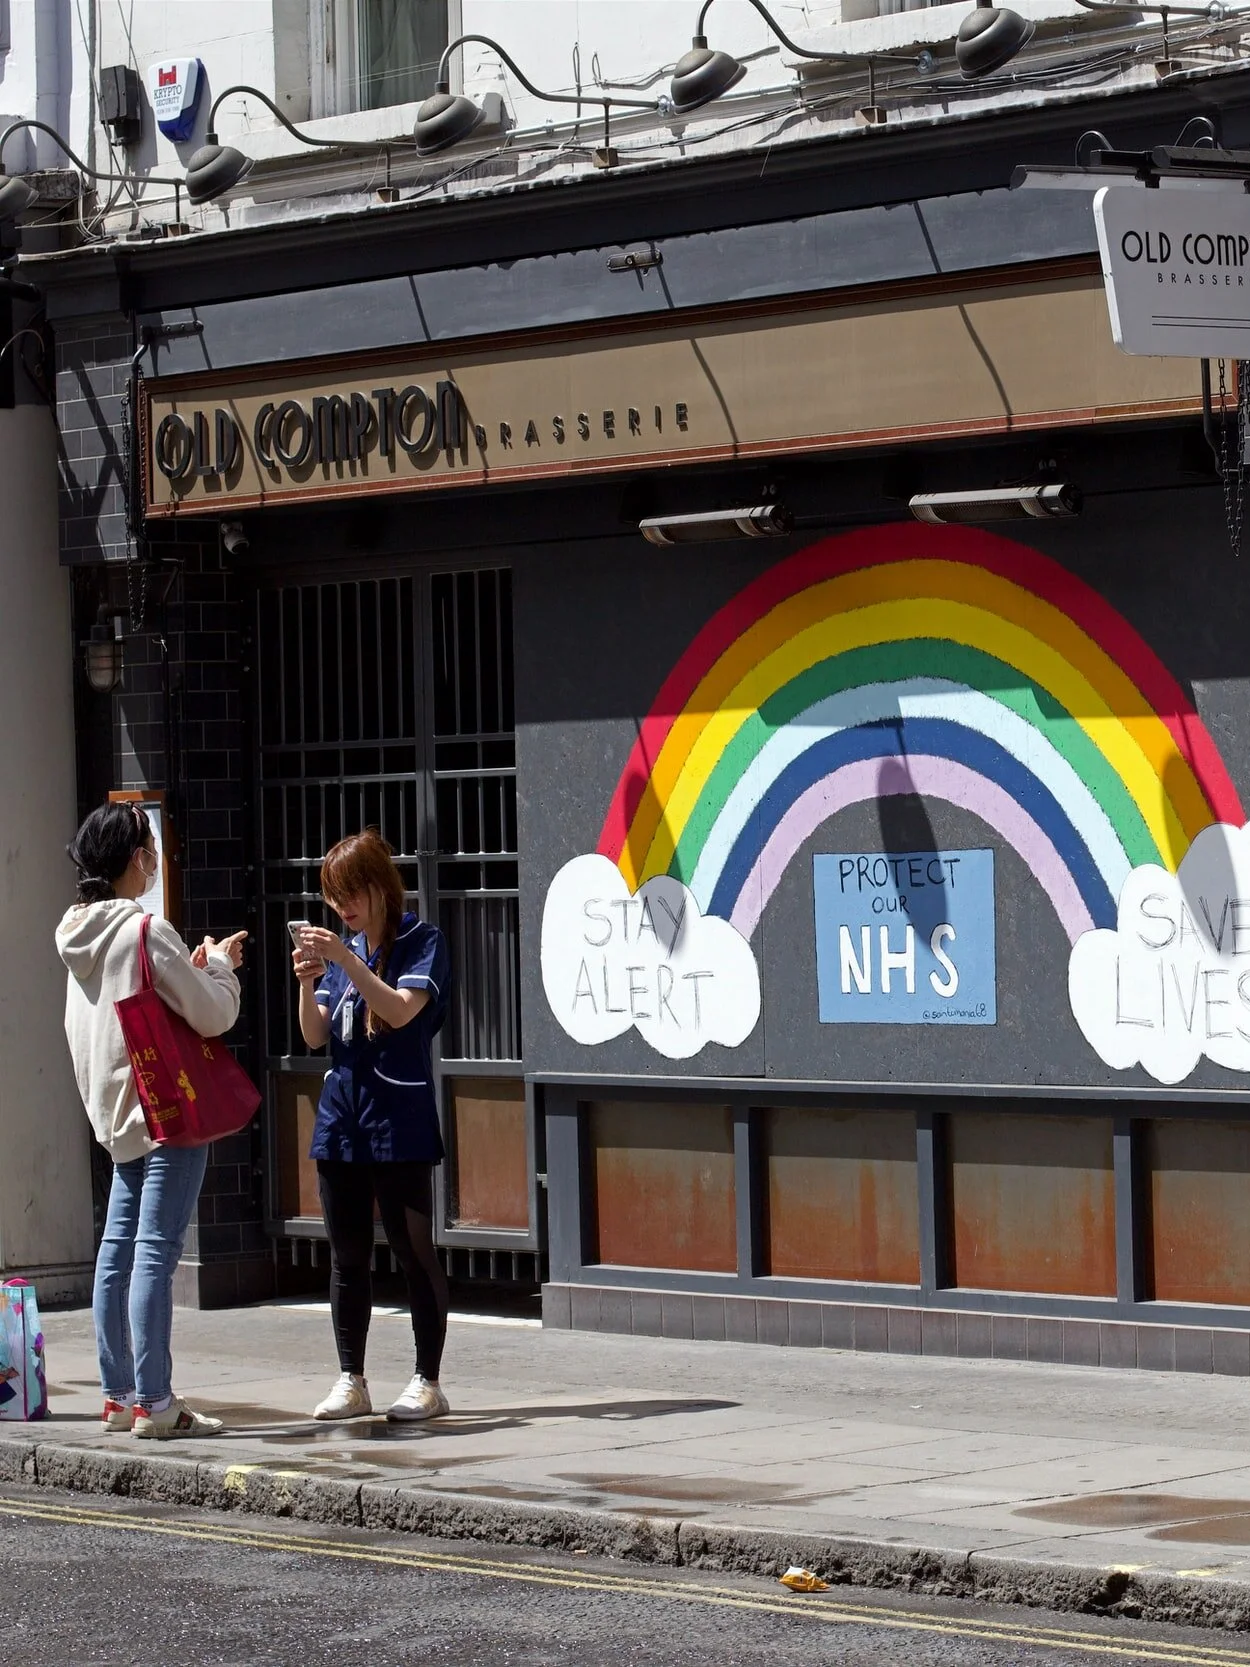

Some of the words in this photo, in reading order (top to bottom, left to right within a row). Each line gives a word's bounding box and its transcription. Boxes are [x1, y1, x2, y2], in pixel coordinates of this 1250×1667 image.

[154, 85, 182, 99] KRYPTO
[156, 97, 180, 107] SECURITY
[1121, 230, 1171, 263] OLD
[155, 408, 238, 480] OLD
[254, 380, 462, 470] COMPTON
[475, 402, 689, 451] BRASSERIE
[839, 857, 961, 892] PROTECT
[871, 897, 910, 915] OUR
[583, 898, 688, 960] STAY
[839, 923, 959, 998] NHS
[571, 953, 714, 1032] ALERT
